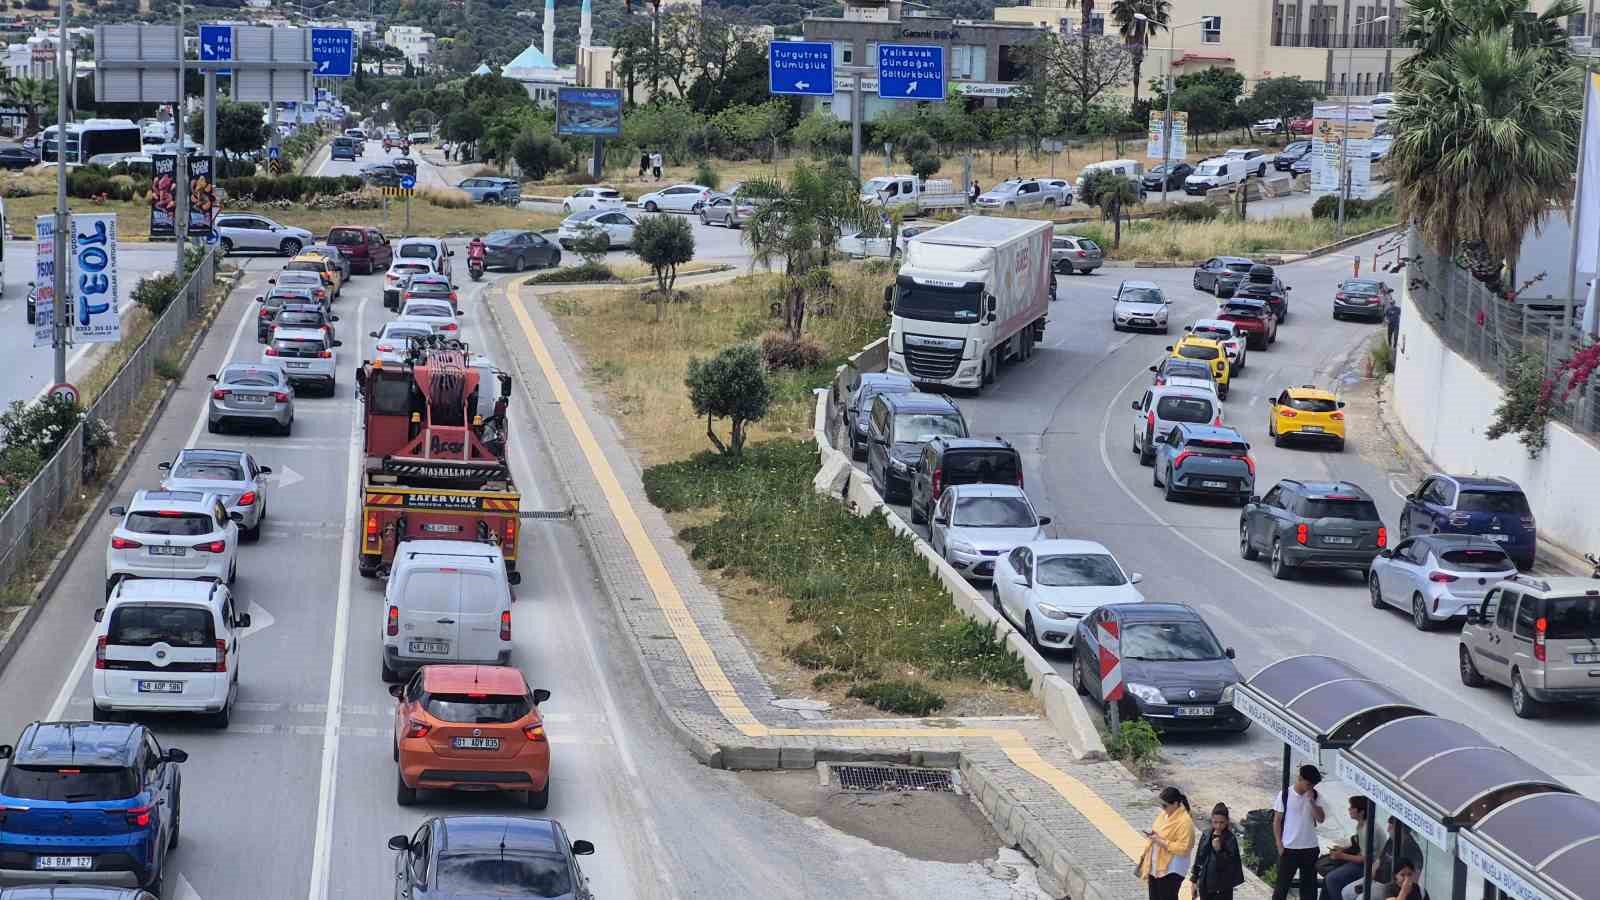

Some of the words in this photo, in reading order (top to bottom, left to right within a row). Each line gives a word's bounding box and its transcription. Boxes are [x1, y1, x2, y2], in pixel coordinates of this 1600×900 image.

[774, 49, 828, 60] Turgutreis
[882, 48, 932, 58] Yalıkavak
[774, 60, 826, 70] Gümüşlük
[881, 58, 935, 69] Gündoğan
[881, 69, 941, 80] Göltürkbükü
[78, 220, 110, 326] TEOL
[409, 494, 447, 503] ZAFER
[42, 857, 51, 866] 48
